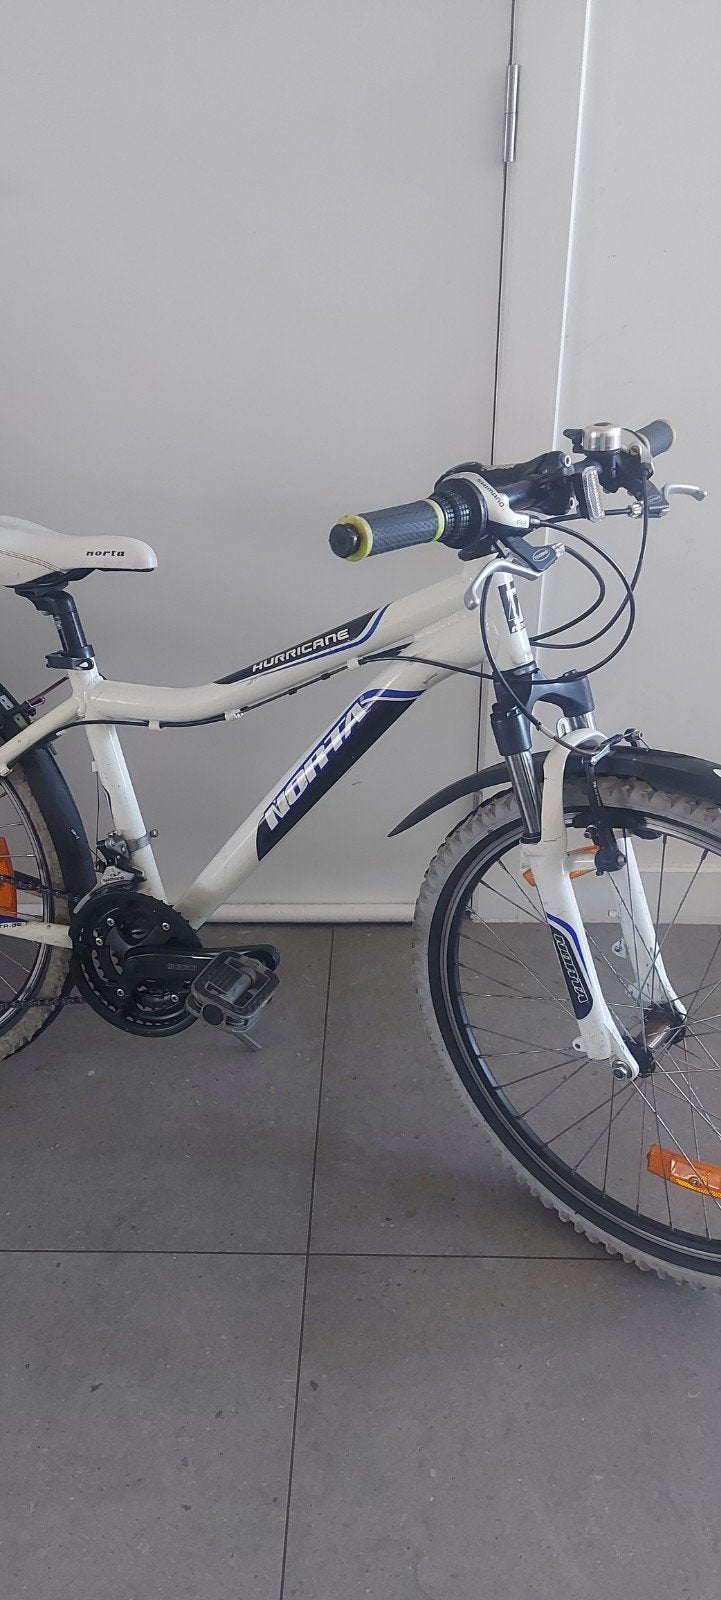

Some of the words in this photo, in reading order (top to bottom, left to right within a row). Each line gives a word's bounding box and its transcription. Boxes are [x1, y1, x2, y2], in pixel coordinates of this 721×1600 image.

[477, 478, 505, 508] SHIMANO
[252, 628, 350, 673] HURRICANE
[259, 702, 367, 831] NORTA
[553, 933, 589, 1004] NORTA
